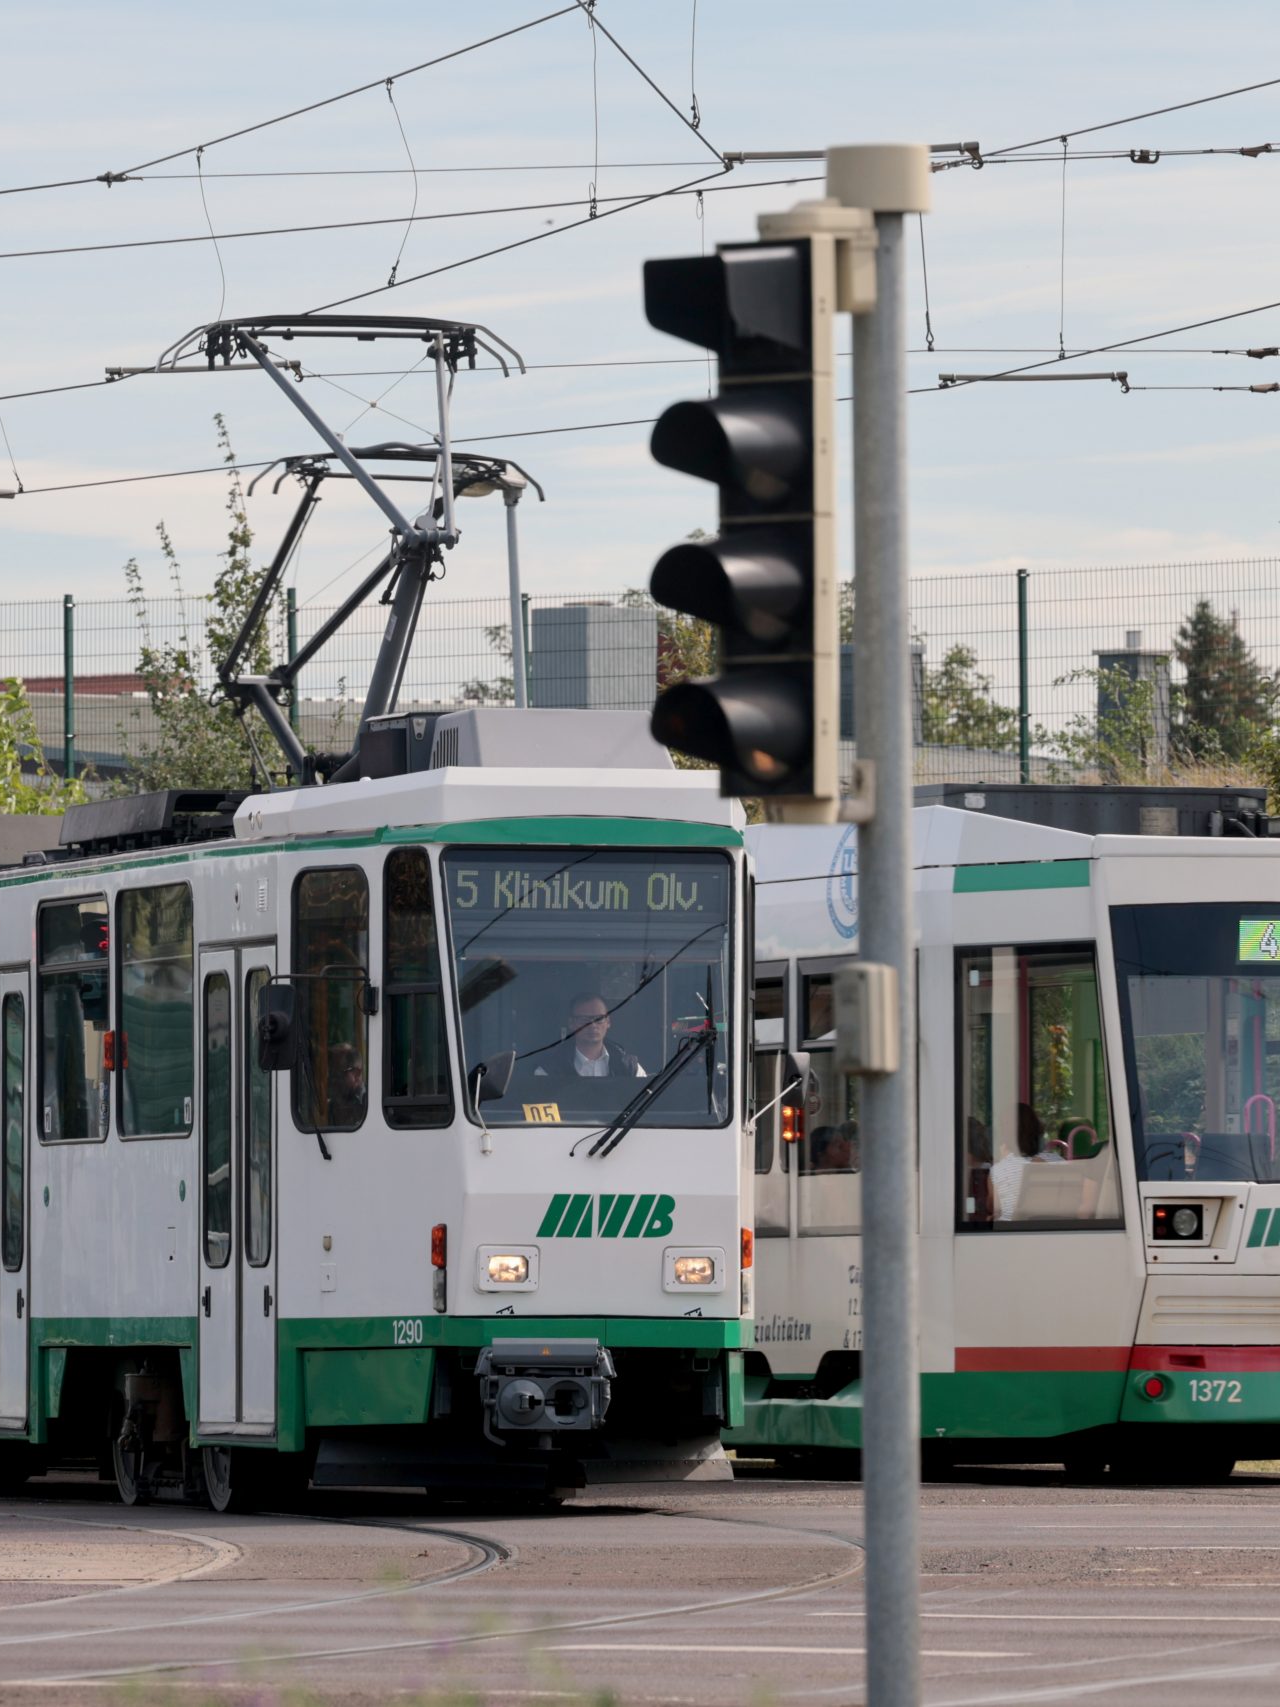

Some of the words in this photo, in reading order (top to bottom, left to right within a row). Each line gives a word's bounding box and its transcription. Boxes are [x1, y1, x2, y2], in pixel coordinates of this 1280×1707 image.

[456, 870, 479, 908] 5
[494, 870, 629, 910] Klinikum
[646, 872, 704, 911] Olv.
[1260, 922, 1279, 959] 4
[536, 1193, 676, 1238] MVB
[392, 1319, 423, 1345] 1290
[1189, 1380, 1242, 1403] 1372
